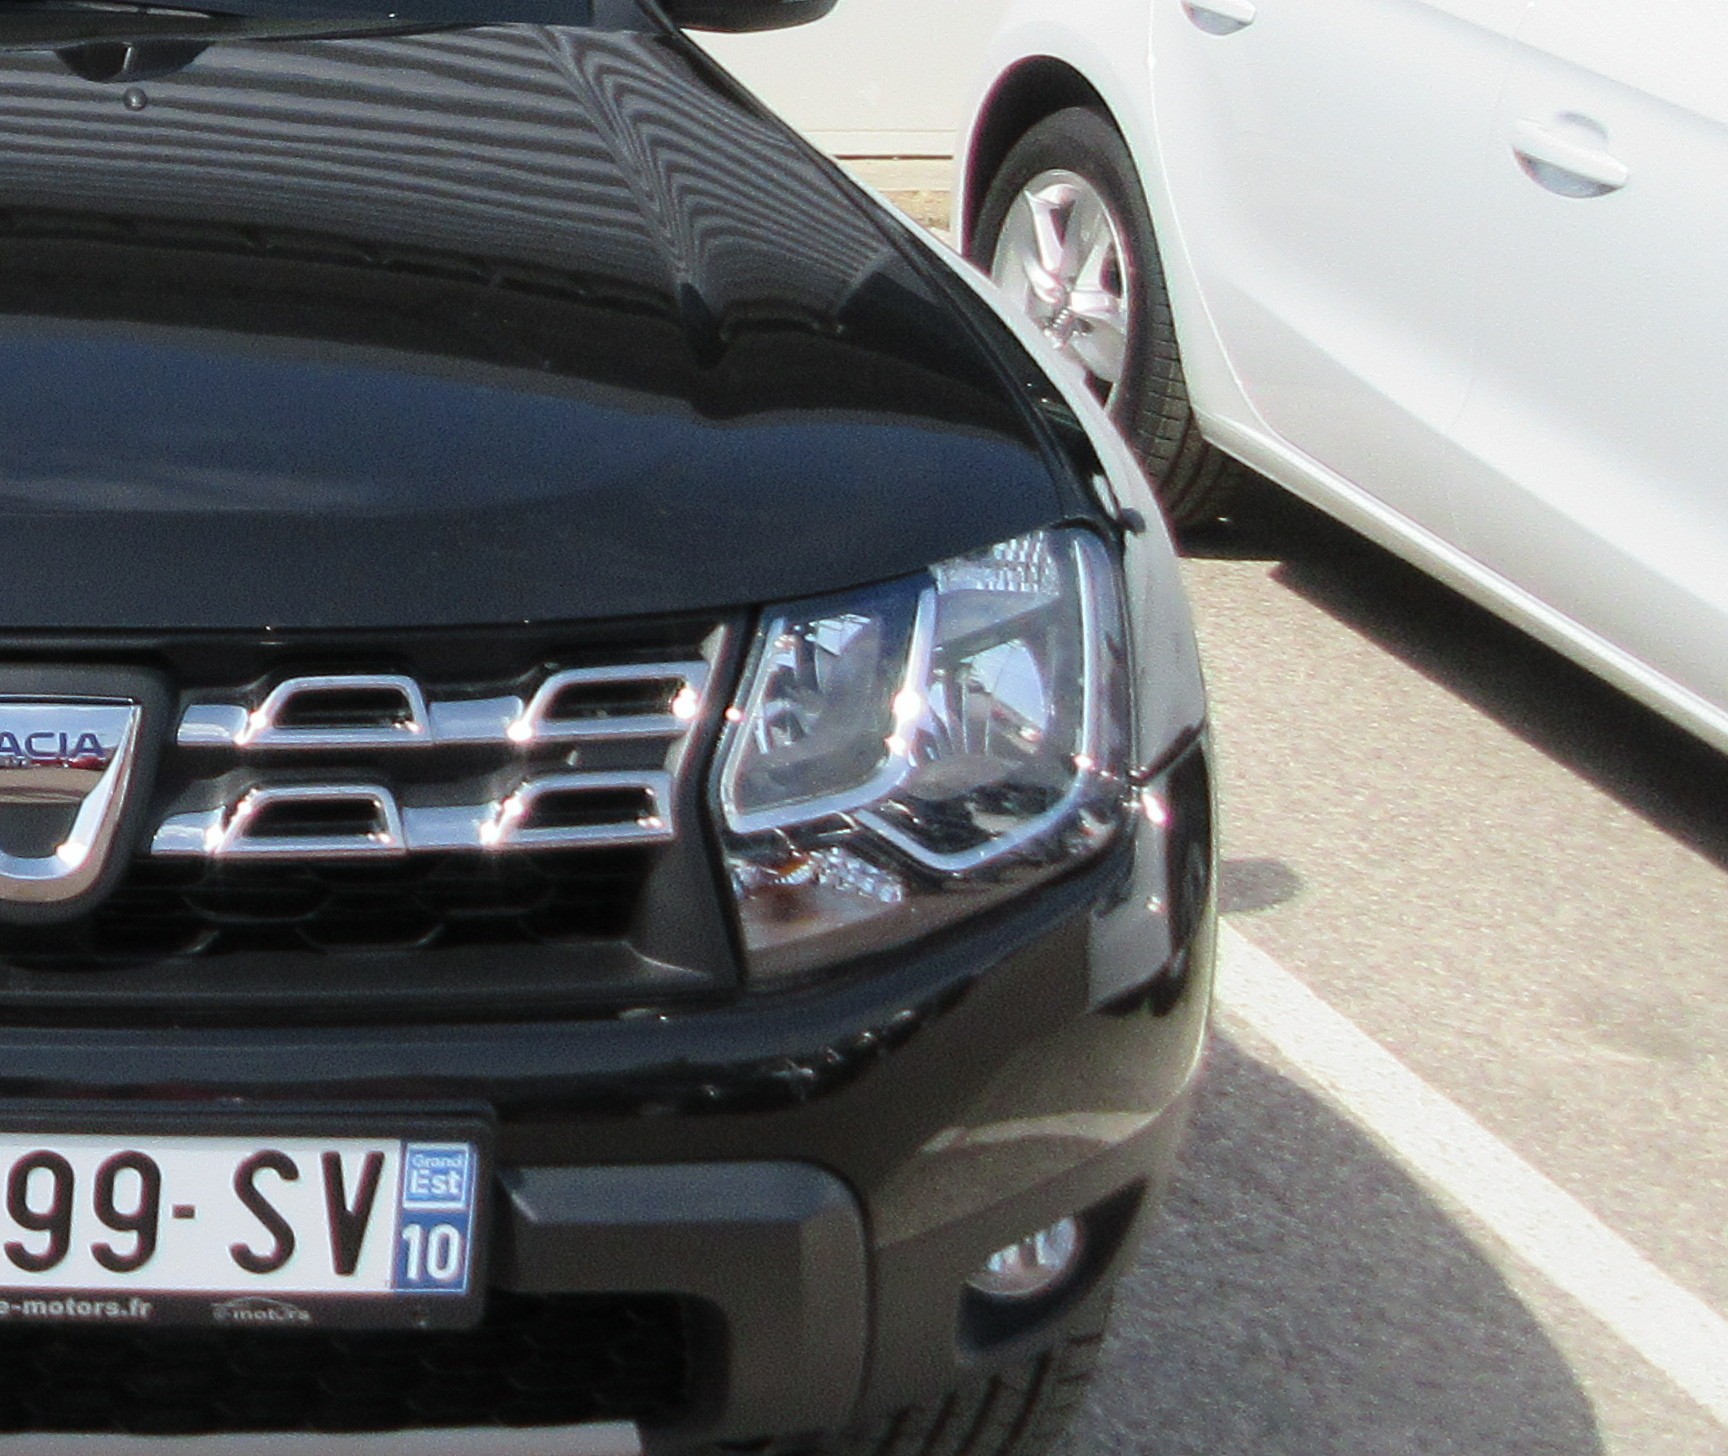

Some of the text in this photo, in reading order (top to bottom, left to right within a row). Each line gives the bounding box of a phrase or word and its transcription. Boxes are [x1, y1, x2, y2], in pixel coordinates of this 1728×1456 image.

[411, 1153, 463, 1168] Grand
[409, 1169, 461, 1194] Est
[401, 1223, 461, 1281] 10
